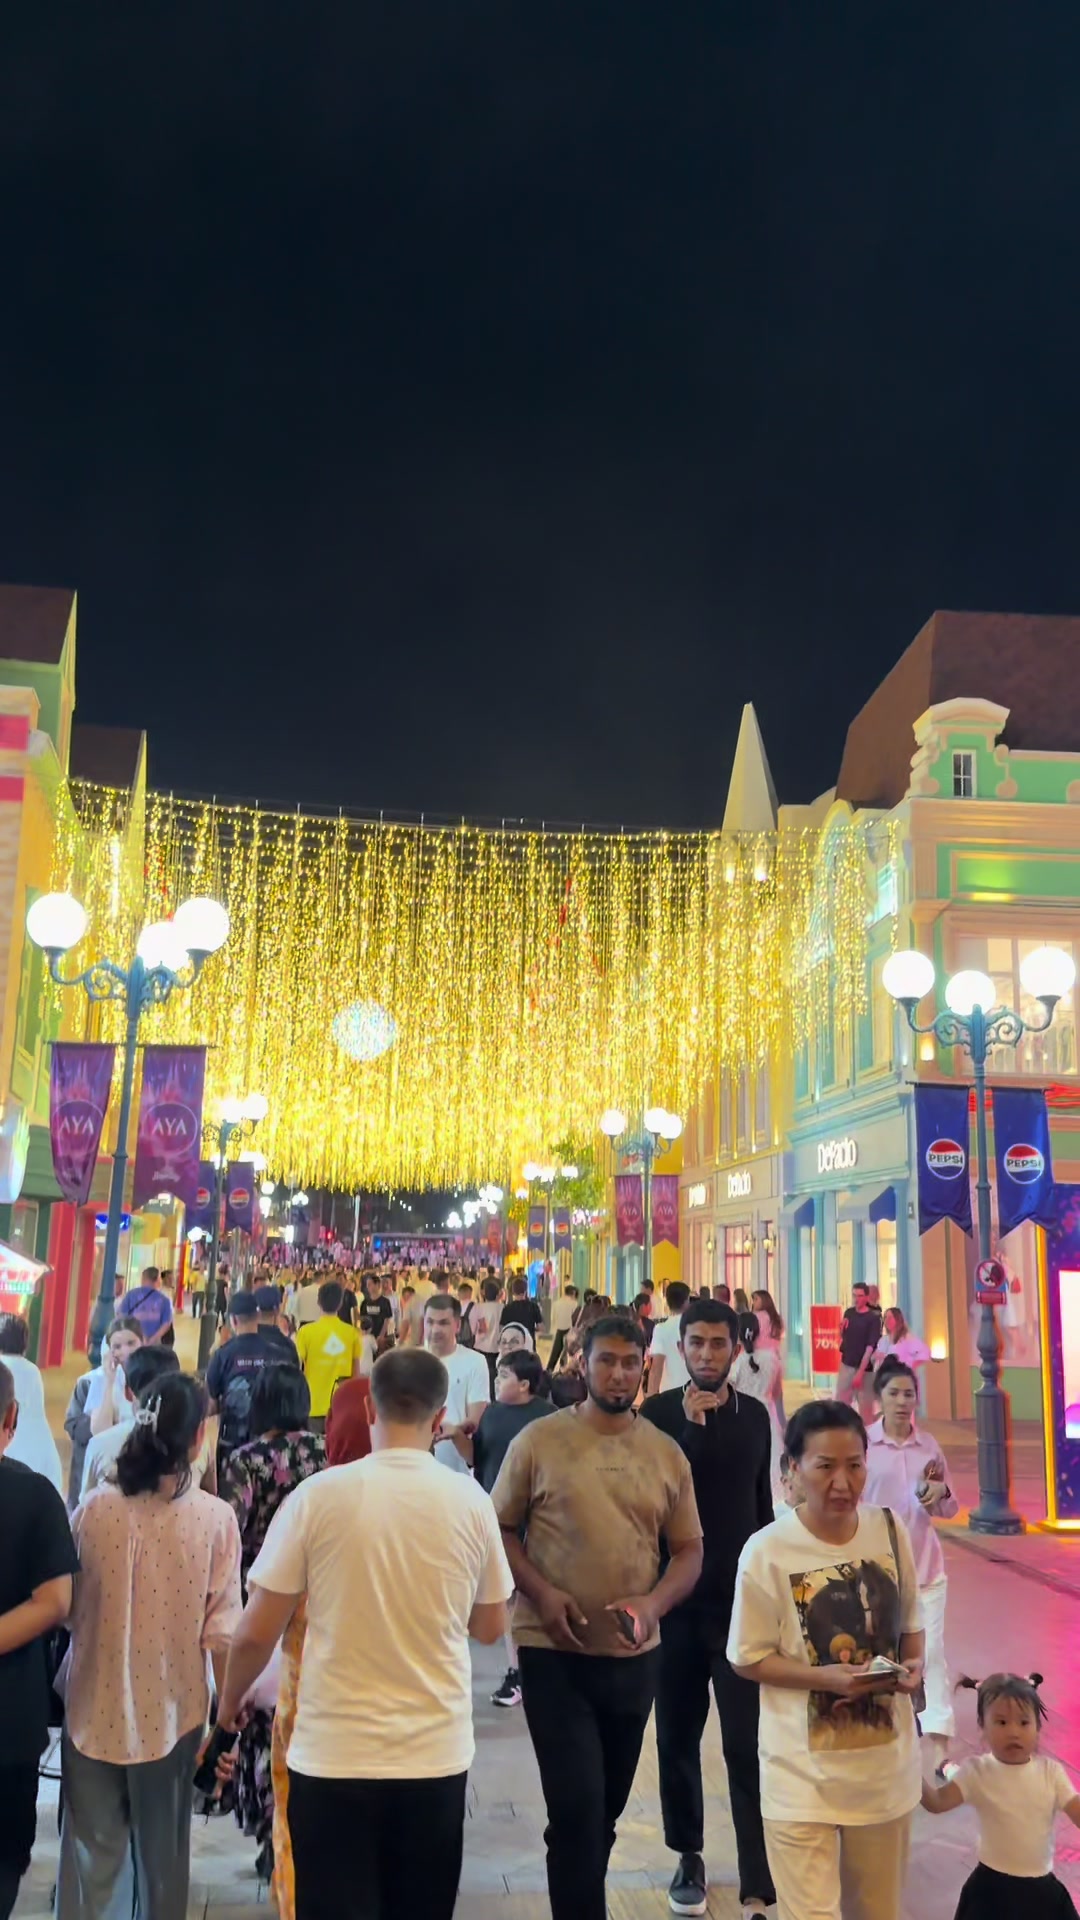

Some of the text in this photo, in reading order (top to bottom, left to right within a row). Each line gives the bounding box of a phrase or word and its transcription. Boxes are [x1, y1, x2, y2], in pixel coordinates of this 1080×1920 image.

[59, 1115, 95, 1135] AYA
[152, 1117, 187, 1136] AYA
[928, 1153, 964, 1165] PEPSI
[1006, 1158, 1042, 1169] PEPSI
[657, 1204, 673, 1216] AYA
